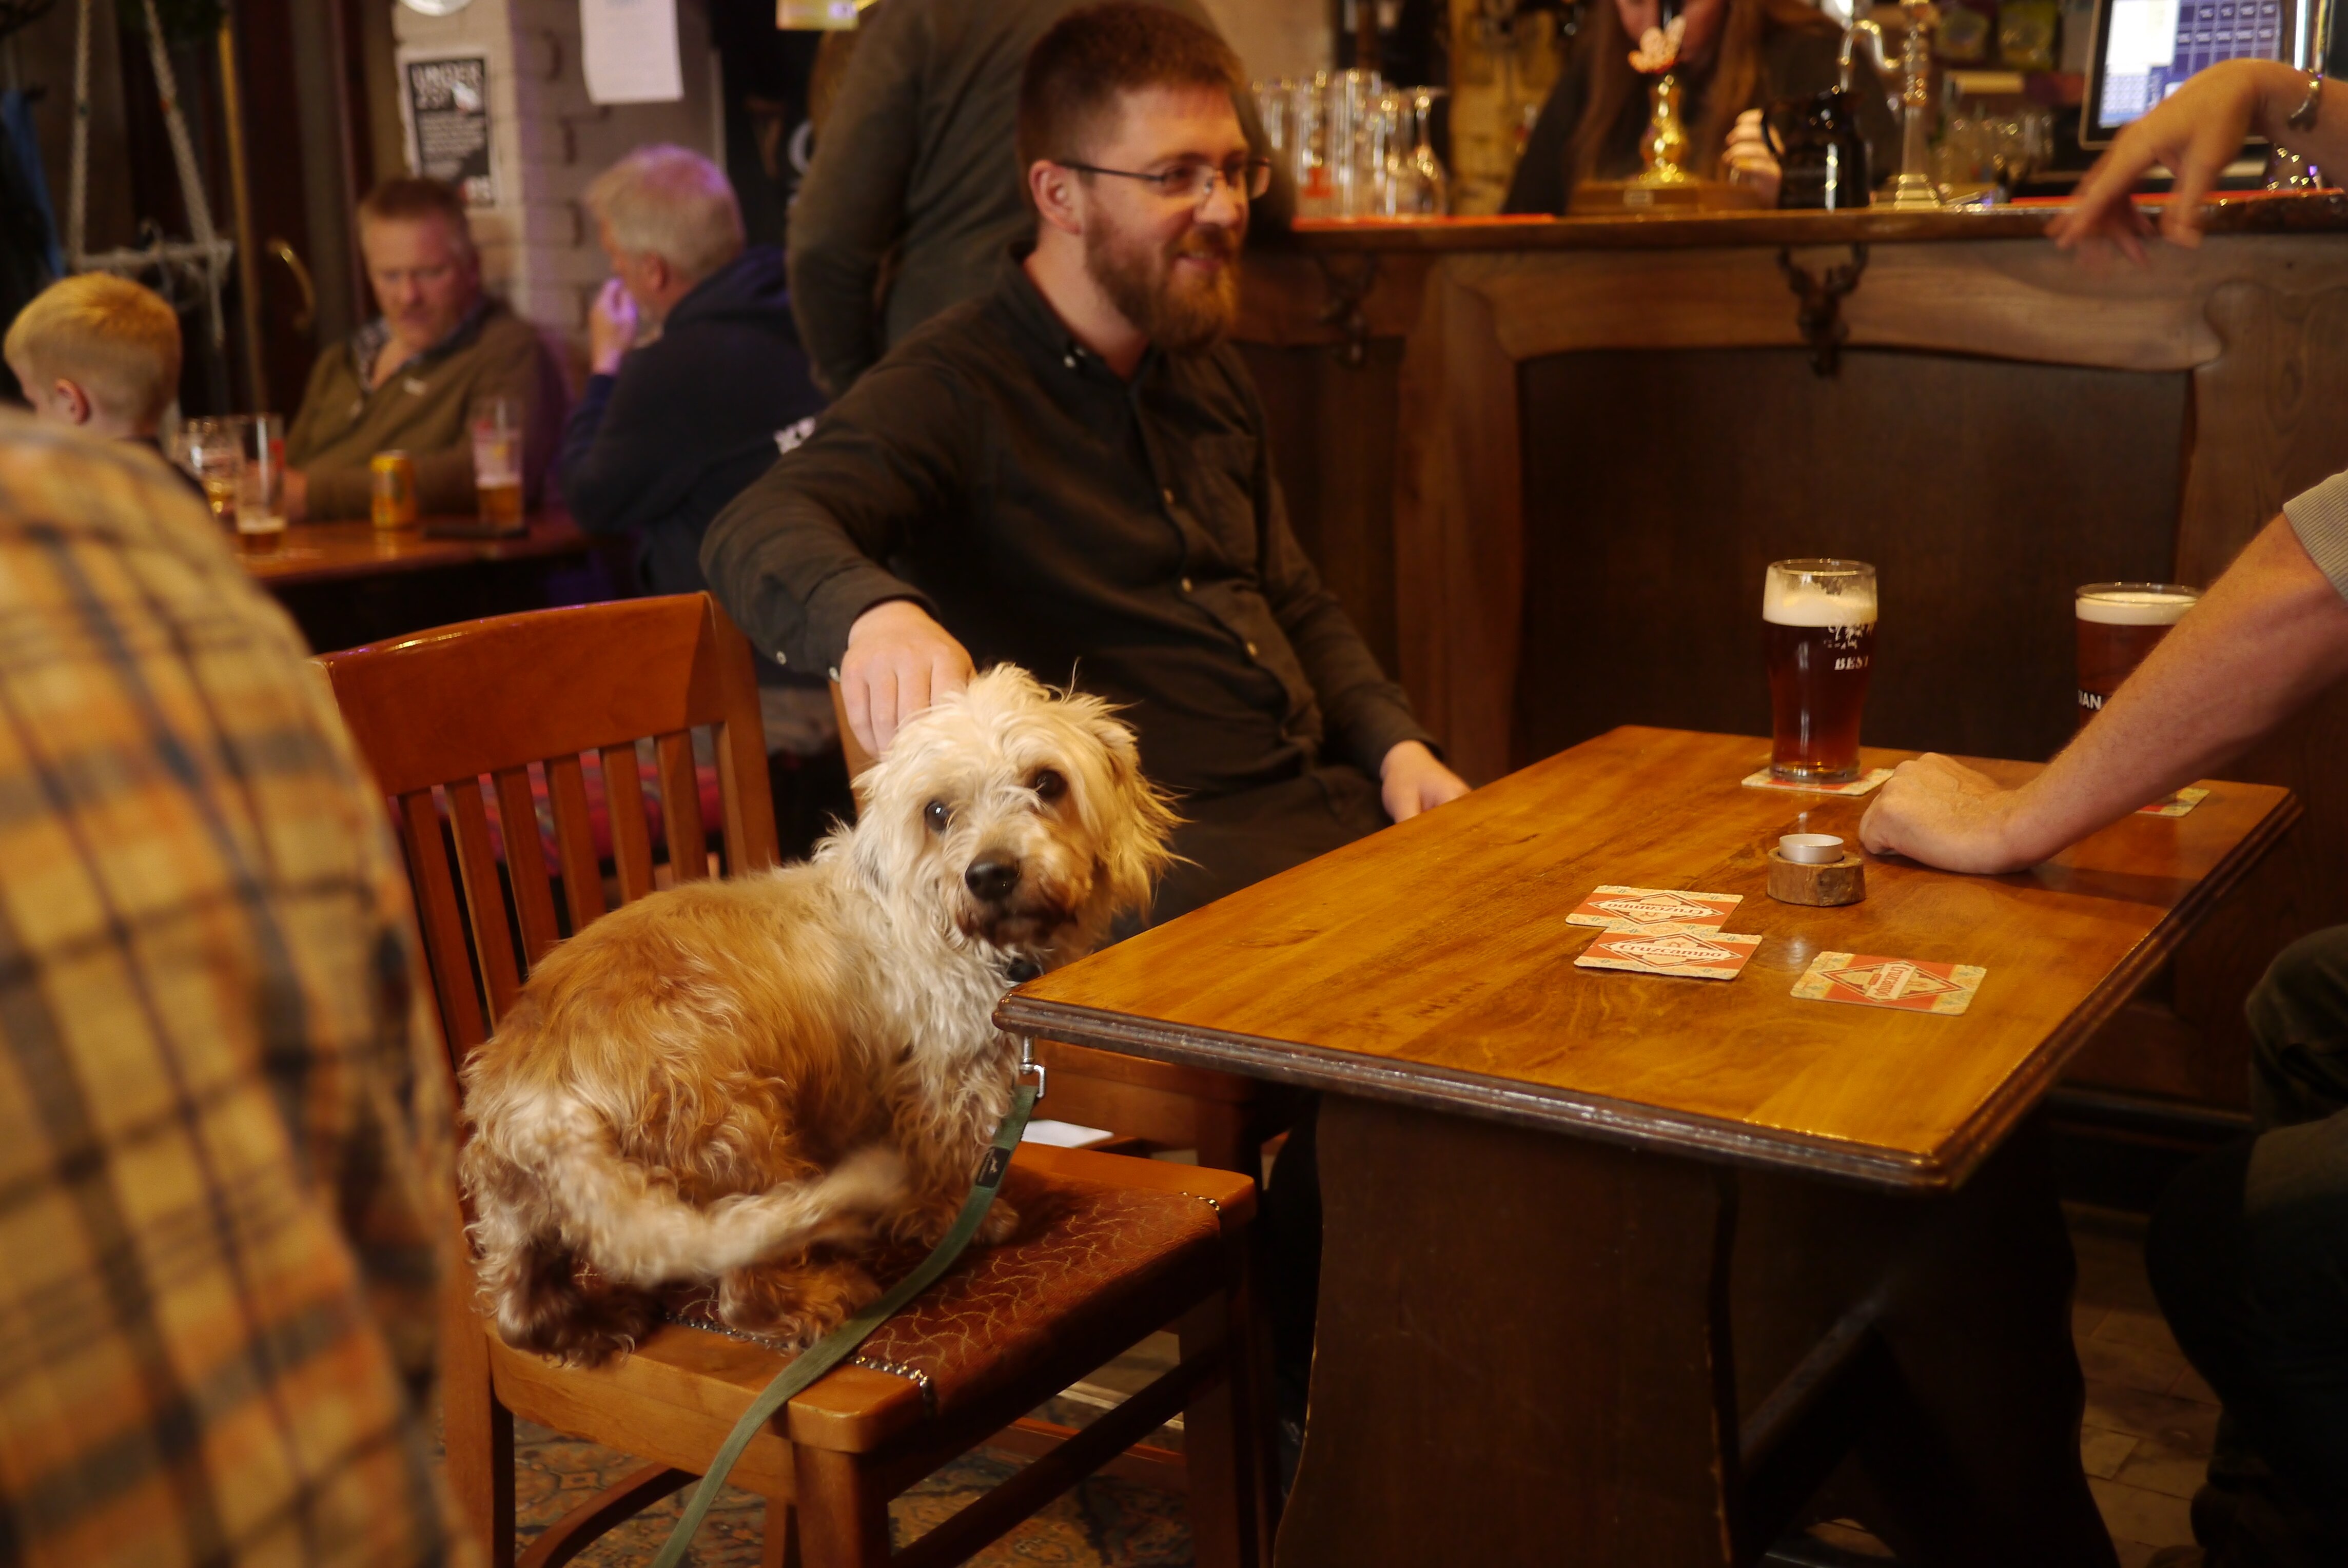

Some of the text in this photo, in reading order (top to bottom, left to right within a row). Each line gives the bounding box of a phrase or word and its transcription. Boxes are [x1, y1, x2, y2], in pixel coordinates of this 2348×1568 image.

[1607, 903, 1705, 916] Cruzcampo
[1618, 943, 1723, 958] Cruzcampo
[1874, 966, 1910, 996] Cruzcampo
